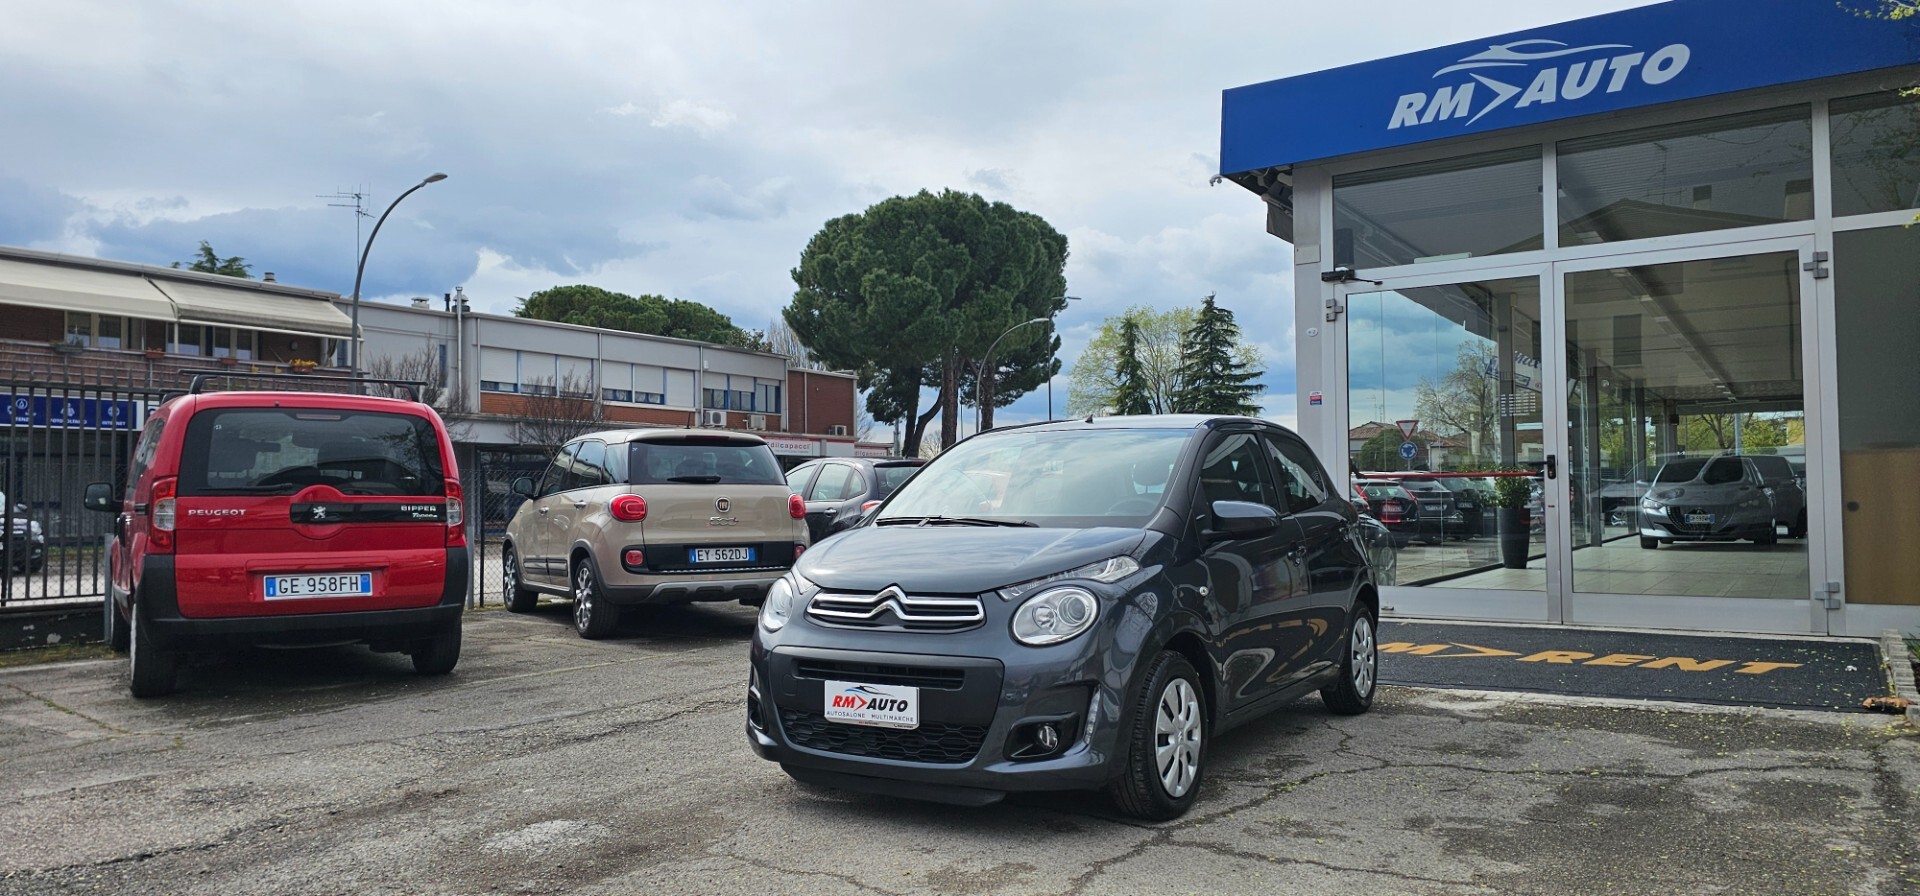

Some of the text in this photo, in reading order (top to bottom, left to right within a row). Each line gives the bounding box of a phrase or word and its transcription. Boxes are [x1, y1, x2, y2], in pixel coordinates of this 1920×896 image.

[1387, 44, 1690, 130] RM AUTO
[767, 441, 811, 450] dilcapacci
[188, 508, 247, 516] PEUGEOT
[400, 504, 437, 512] BIPPER
[697, 549, 710, 561] EY
[714, 548, 749, 561] 562DJ
[279, 578, 300, 595] GE
[306, 576, 360, 593] 958FH
[1377, 641, 1804, 675] M RENT
[832, 695, 909, 713] RM AUTO
[827, 711, 914, 722] AUTOSALONE MULTIMARCHE
